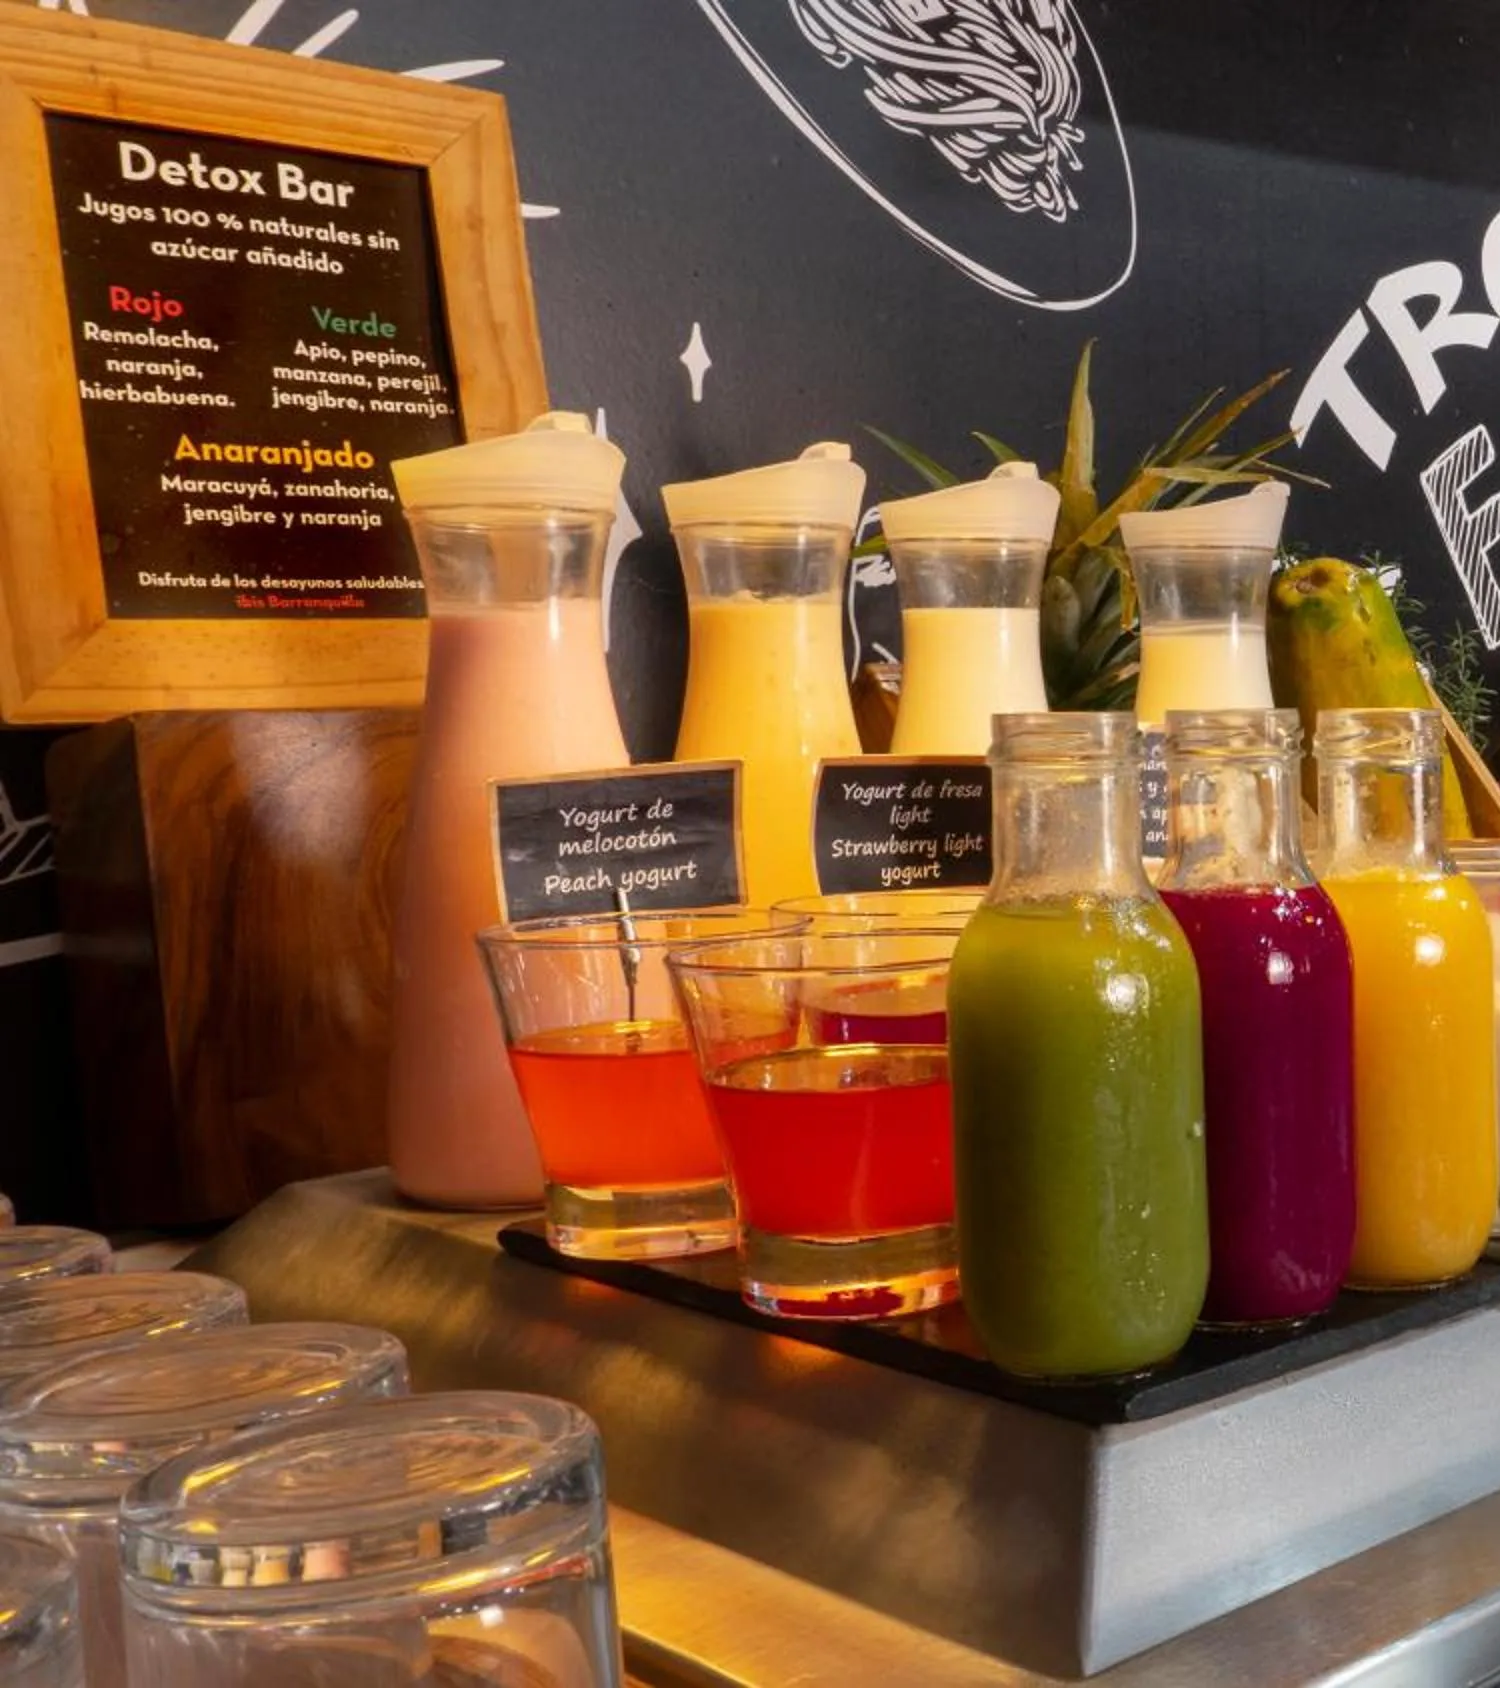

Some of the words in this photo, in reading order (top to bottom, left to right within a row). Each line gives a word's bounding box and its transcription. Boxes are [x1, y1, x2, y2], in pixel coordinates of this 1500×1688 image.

[118, 140, 266, 196] Detox
[276, 161, 355, 208] Bar
[77, 192, 157, 223] Jugos
[162, 206, 211, 227] 100
[216, 213, 244, 231] %
[249, 216, 363, 248] naturales
[367, 230, 400, 251] sin
[150, 237, 239, 262] azúcar
[245, 247, 344, 275] añadido
[108, 285, 184, 323] Rojo
[311, 305, 398, 338] Verde
[82, 321, 220, 353] Remolacha,
[106, 355, 204, 380] naranja,
[293, 339, 347, 363] Apio,
[351, 348, 427, 369] pepino,
[272, 364, 372, 389] manzana,
[79, 380, 237, 408] hierbabuena.
[271, 387, 366, 413] jengibre,
[370, 396, 455, 417] naranja.
[174, 433, 375, 473] Anaranjado
[160, 474, 279, 498] Maracuyá,
[284, 479, 395, 501] zanahoria,
[184, 504, 276, 527] jengibre
[282, 511, 295, 529] y
[300, 509, 382, 530] naranja
[138, 571, 207, 588] Disfruta
[210, 574, 230, 588] de
[233, 573, 257, 588] los
[261, 575, 343, 591] desayunos
[345, 575, 425, 589] saludables
[842, 780, 906, 806] Yogurt
[911, 779, 933, 799] de
[939, 778, 983, 799] fresa
[559, 803, 639, 832] Yogurt
[646, 797, 673, 820] de
[889, 804, 932, 830] light
[559, 825, 677, 857] melocotón
[831, 834, 938, 859] Strawberry
[944, 832, 984, 857] light
[1145, 830, 1169, 842] an
[544, 867, 613, 896] Peach
[618, 860, 698, 892] yogurt
[881, 861, 941, 887] yogurt
